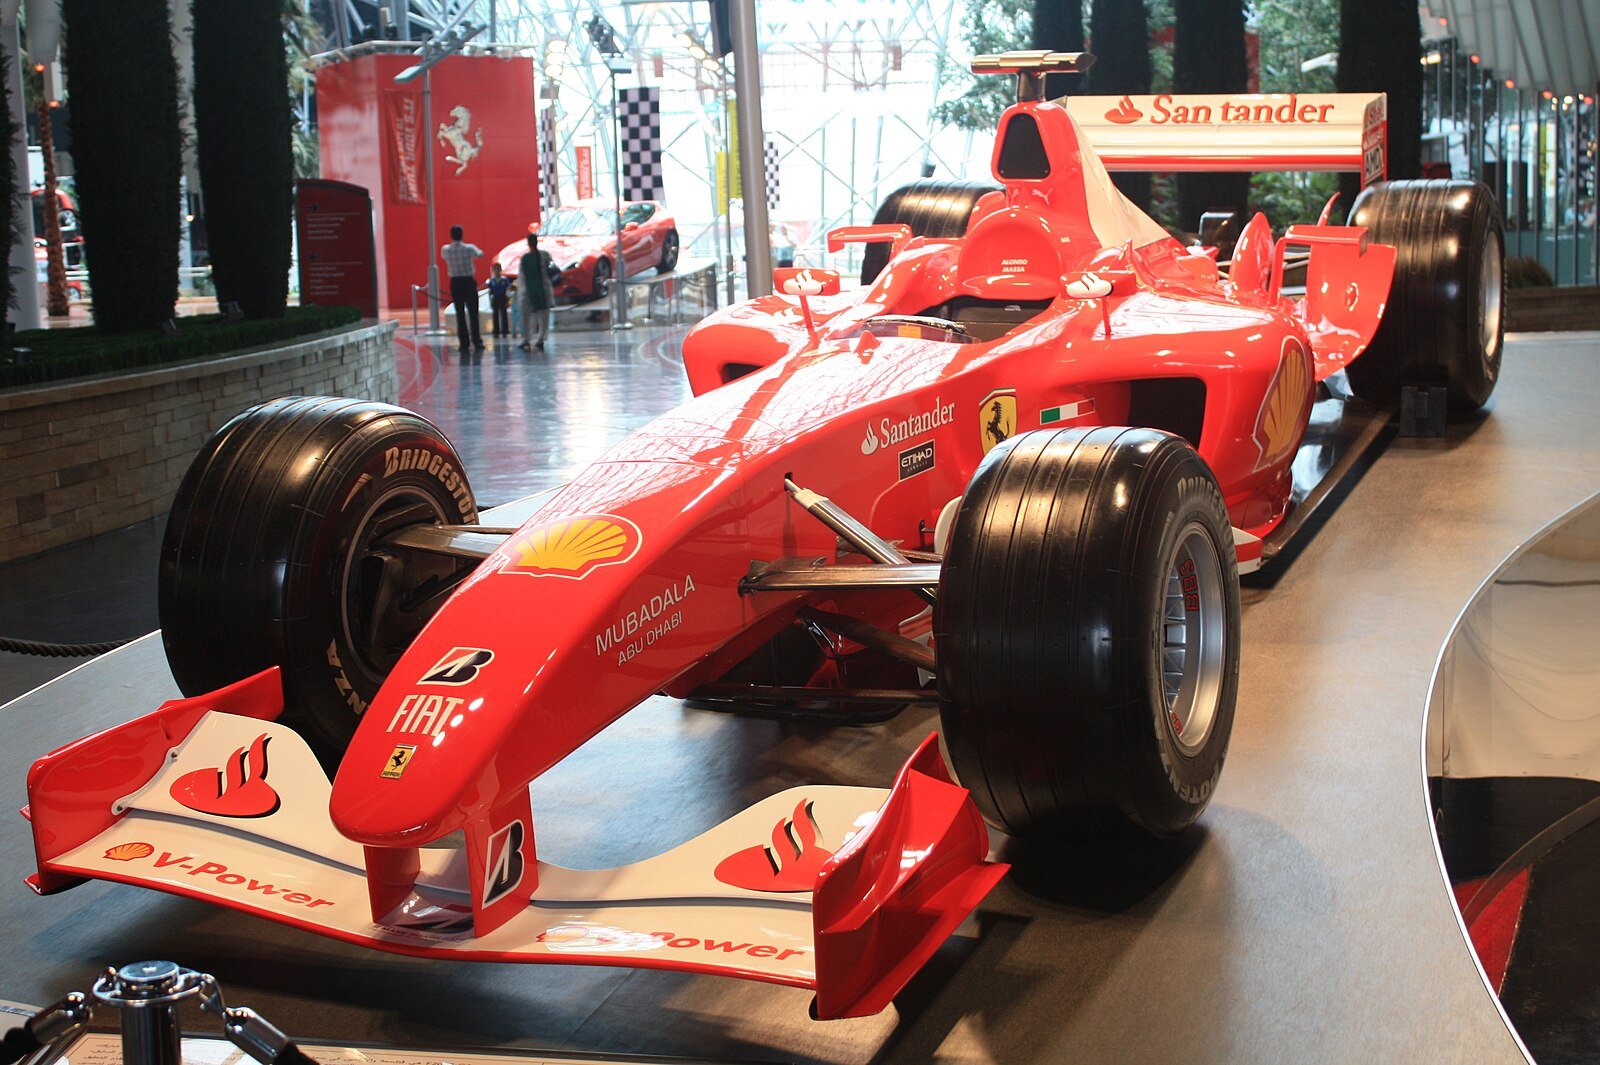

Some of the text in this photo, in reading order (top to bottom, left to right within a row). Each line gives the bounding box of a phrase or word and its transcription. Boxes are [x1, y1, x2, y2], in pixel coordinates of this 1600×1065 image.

[880, 396, 956, 449] Santander
[383, 446, 477, 525] BRIDGESTON
[901, 447, 933, 468] ETIHAD
[595, 574, 696, 656] MUBADALA
[618, 610, 682, 667] ABU DHABI
[386, 694, 465, 738] FIAT
[152, 851, 335, 909] V-Power
